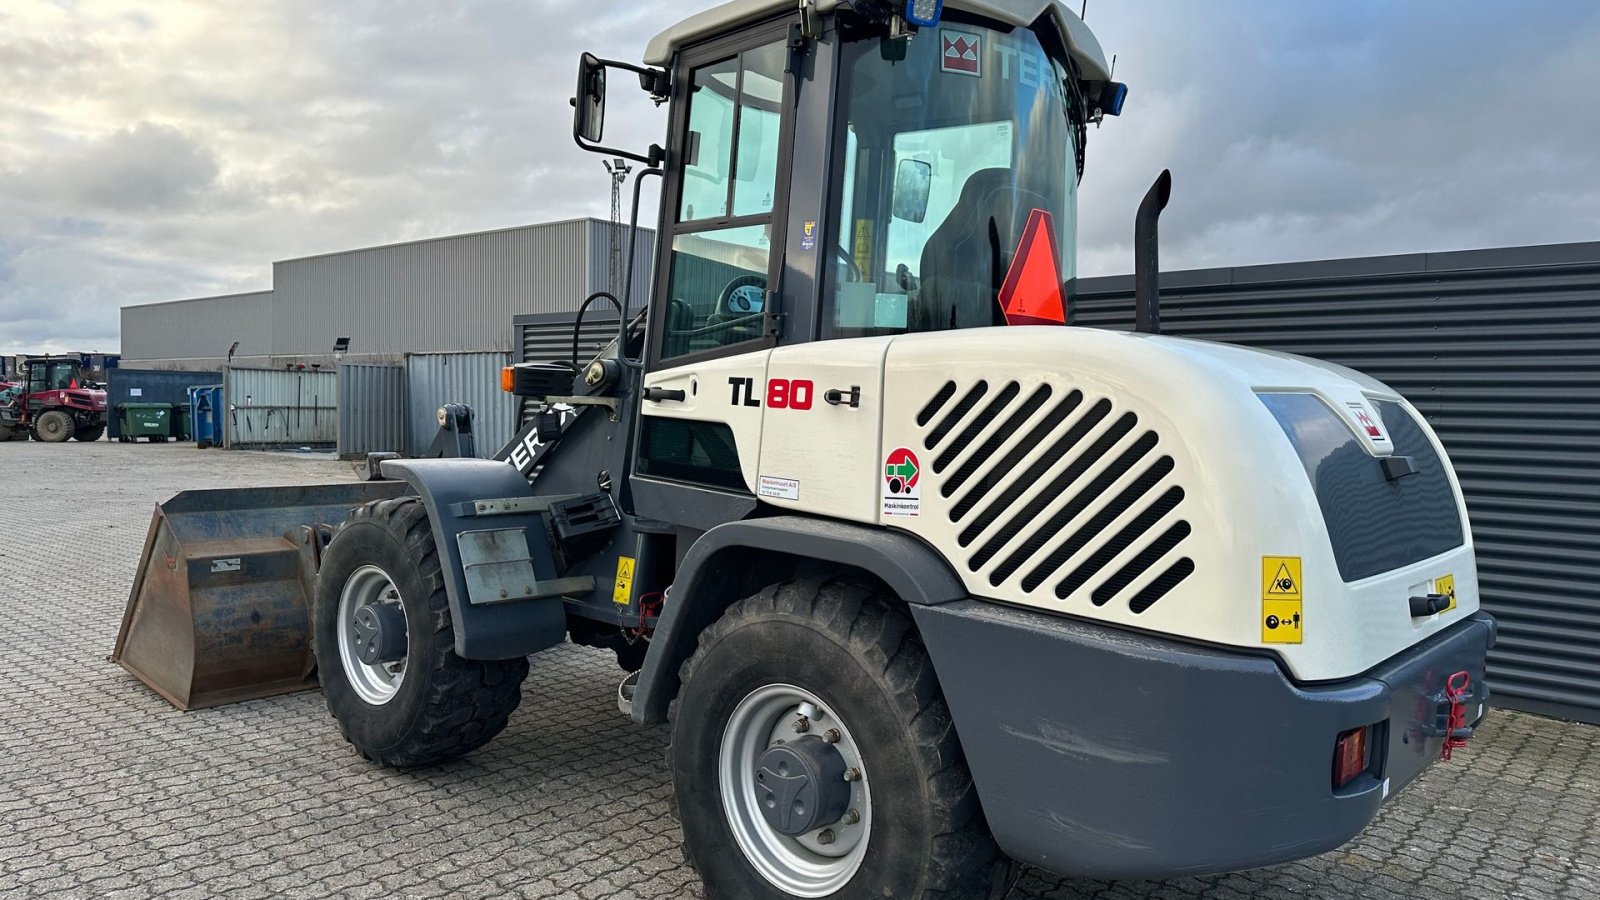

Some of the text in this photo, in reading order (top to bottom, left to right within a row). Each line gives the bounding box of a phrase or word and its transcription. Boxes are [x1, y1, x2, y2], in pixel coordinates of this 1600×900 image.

[728, 376, 814, 411] TL 80
[884, 502, 919, 510] Maskinkontrol
